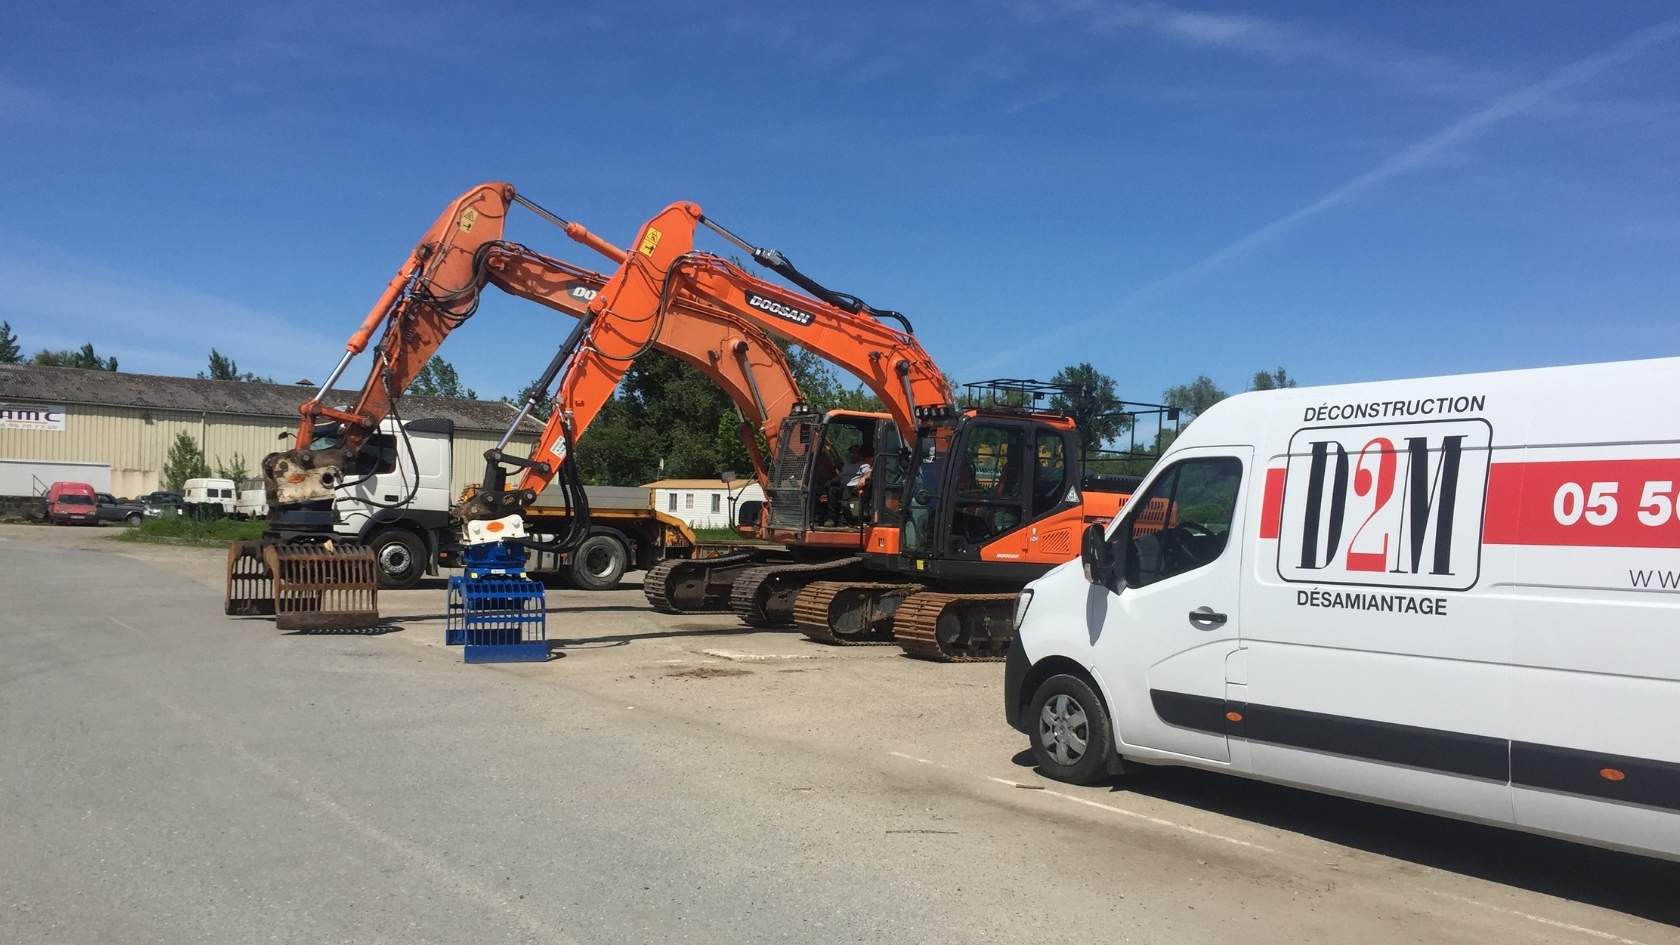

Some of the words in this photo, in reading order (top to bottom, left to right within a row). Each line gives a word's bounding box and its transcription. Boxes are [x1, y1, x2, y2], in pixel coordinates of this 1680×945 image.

[749, 295, 810, 323] DOOSAN
[1303, 395, 1486, 422] DÉCONSTRUCTION
[1295, 435, 1469, 576] D2M
[1553, 481, 1619, 527] 05
[1637, 480, 1680, 527] 5
[1297, 587, 1448, 616] DÉSAMIANTAGE
